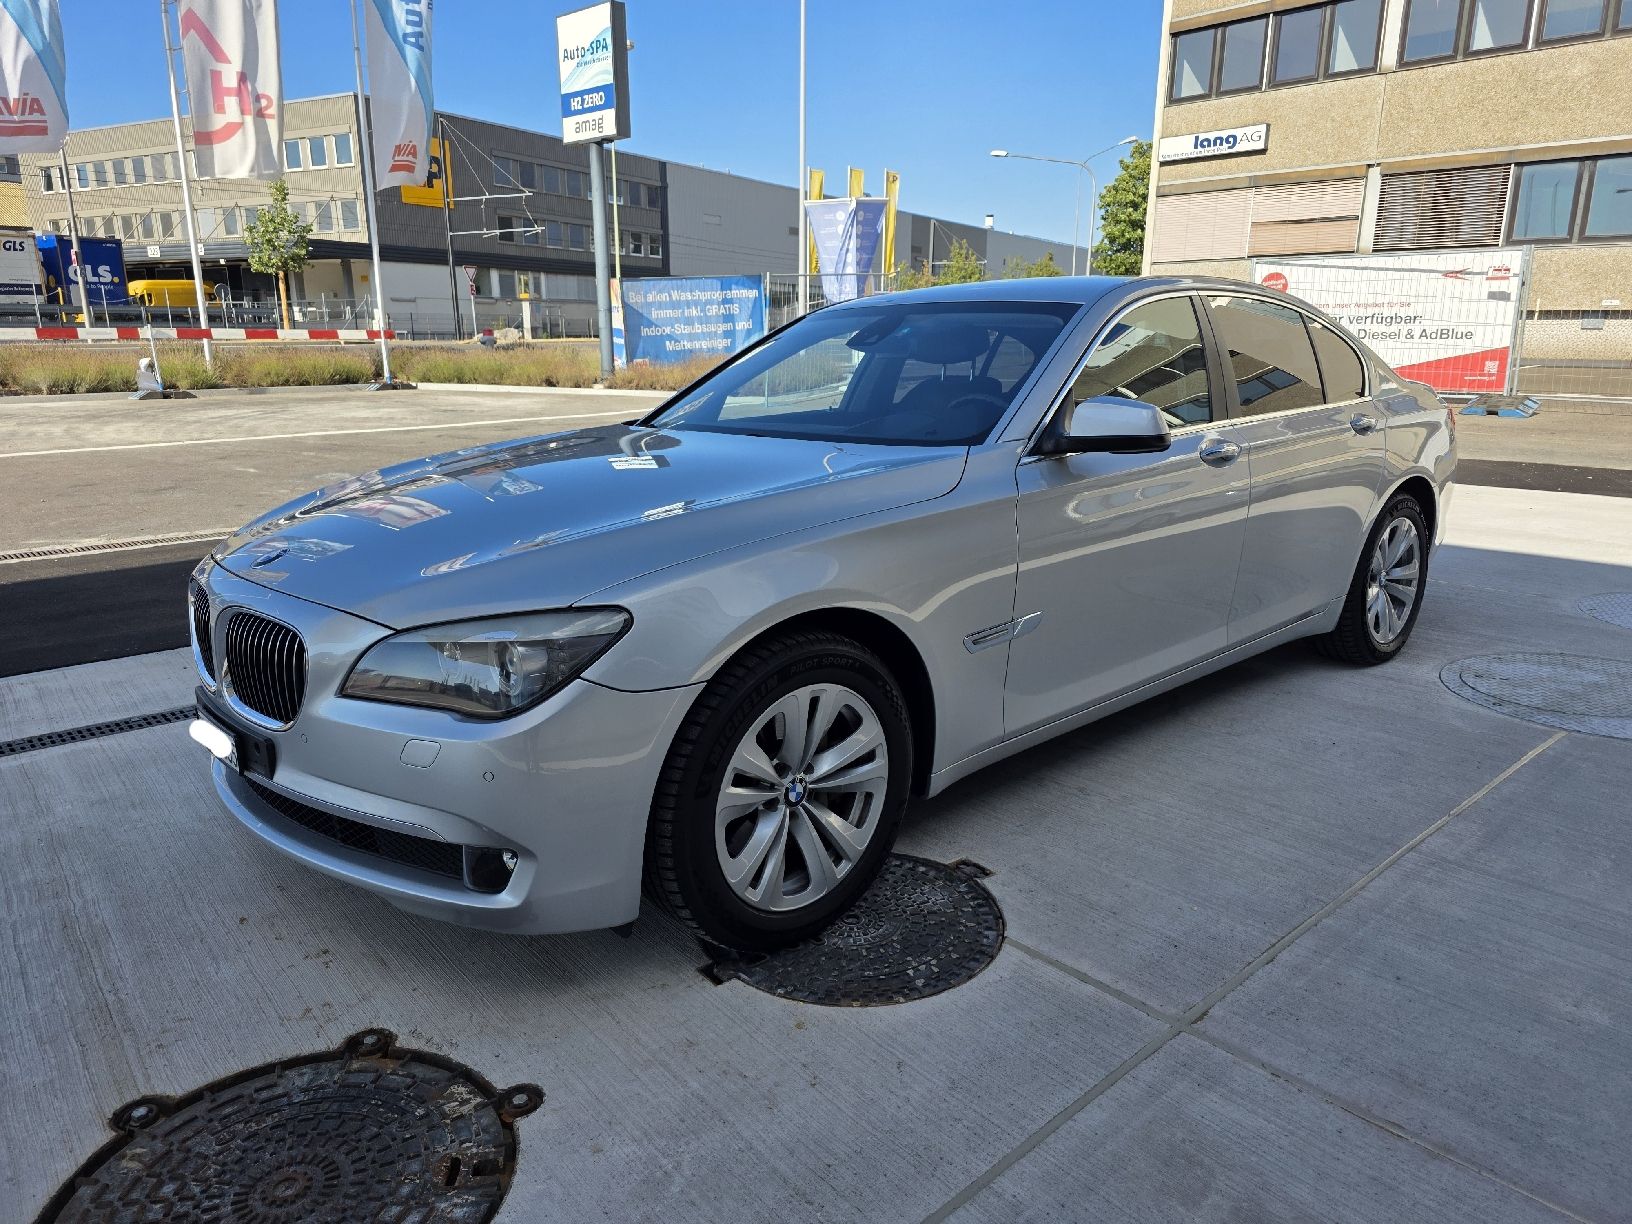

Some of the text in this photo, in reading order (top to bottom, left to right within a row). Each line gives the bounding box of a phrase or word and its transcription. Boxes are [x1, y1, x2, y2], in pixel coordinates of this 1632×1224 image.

[562, 37, 609, 62] Auto-SPA
[209, 68, 276, 119] H2
[570, 91, 605, 111] H2 ZERO
[0, 92, 47, 117] VIA
[574, 115, 604, 134] amag
[3, 240, 25, 252] GLS
[629, 289, 759, 302] Bei allen Waschprogrammen
[652, 304, 740, 319] immer inkl. GRATIS
[1353, 301, 1385, 310] Angebot
[1348, 311, 1423, 326] verfügbar:
[640, 319, 753, 337] Indoor-Staubsaugen und
[1357, 328, 1474, 341] Diesel & AdBlue
[665, 338, 732, 351] Mattenreiniger
